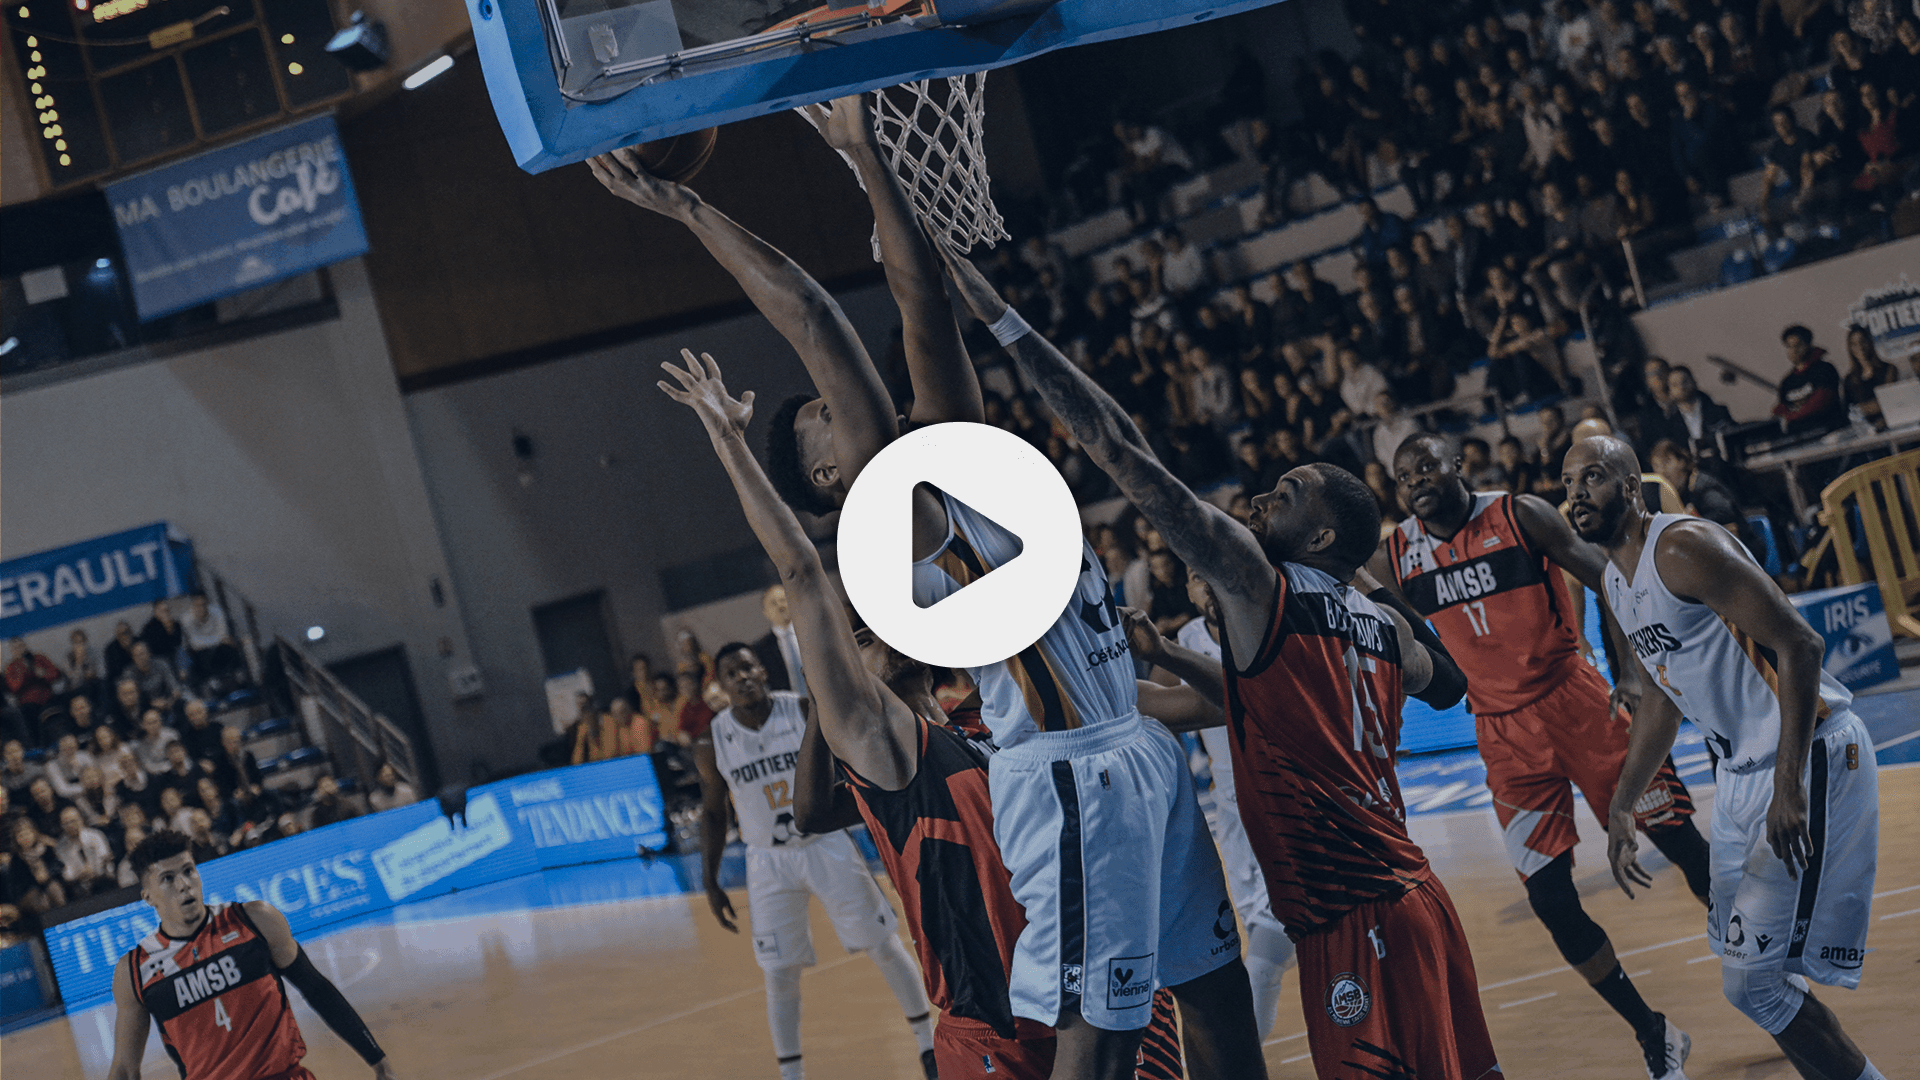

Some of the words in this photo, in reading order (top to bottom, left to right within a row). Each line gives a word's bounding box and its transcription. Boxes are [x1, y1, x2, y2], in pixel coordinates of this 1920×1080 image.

[114, 195, 160, 229] MA
[167, 135, 340, 212] BOULANGERIE
[1434, 561, 1497, 606] AMSB
[1462, 600, 1490, 637] 17
[1823, 594, 1870, 634] IRIS
[1846, 743, 1859, 770] 9
[764, 780, 793, 811] 12
[517, 786, 661, 848] TENDANCES
[173, 954, 242, 1008] AMSB
[1112, 983, 1149, 997] vienne
[1334, 988, 1361, 1006] AMSB
[214, 997, 232, 1032] 4
